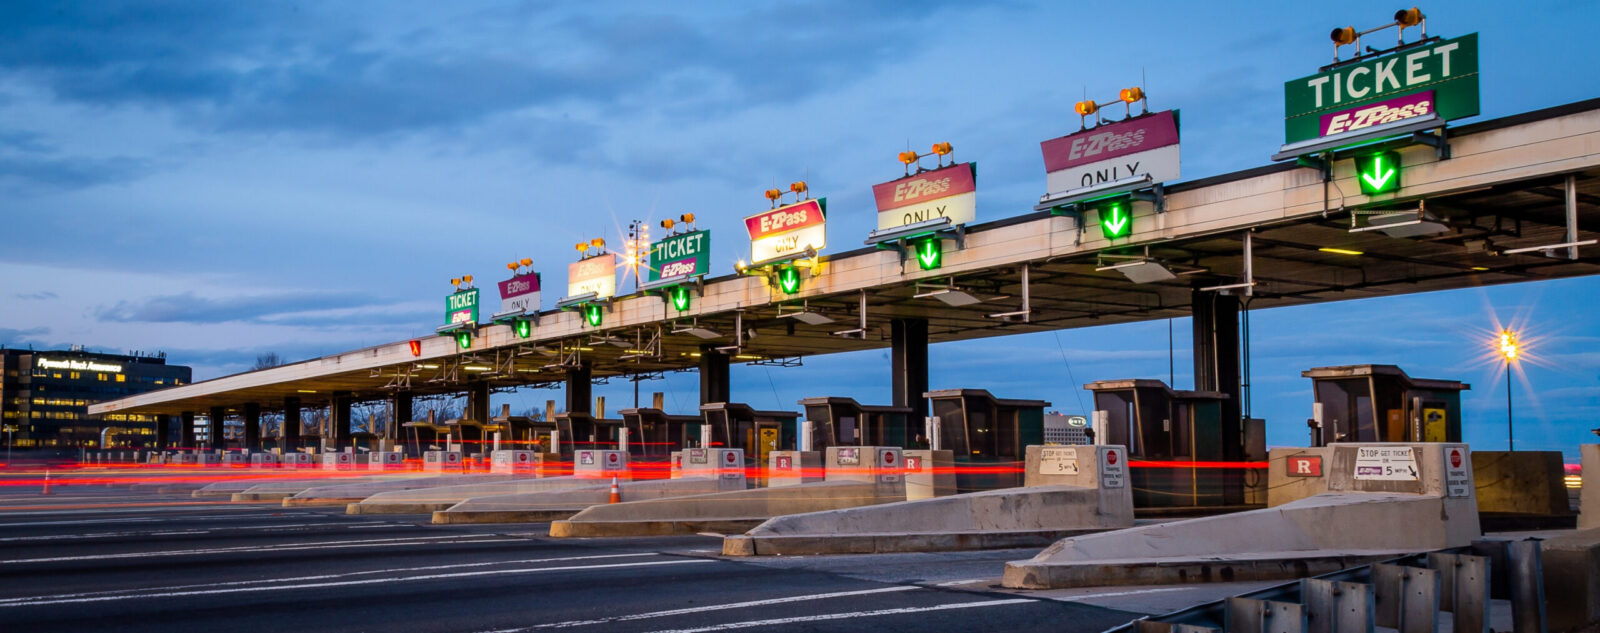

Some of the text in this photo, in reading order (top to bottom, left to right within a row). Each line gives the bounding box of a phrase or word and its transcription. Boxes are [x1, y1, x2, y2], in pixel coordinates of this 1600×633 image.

[1308, 42, 1459, 108] TICKET
[1069, 129, 1147, 160] E-ZPass
[894, 177, 951, 202] E-ZPass
[760, 210, 808, 232] E-ZPass
[656, 233, 703, 261] TICKET
[776, 236, 799, 253] ONLY
[661, 262, 695, 278] E-ZPass
[449, 290, 476, 309] TICKET
[511, 298, 530, 310] ONLY
[1360, 449, 1379, 458] STOP
[780, 458, 788, 468] R
[907, 458, 915, 469] R
[1059, 463, 1064, 471] 5
[1297, 459, 1312, 474] R
[1386, 466, 1393, 476] 5
